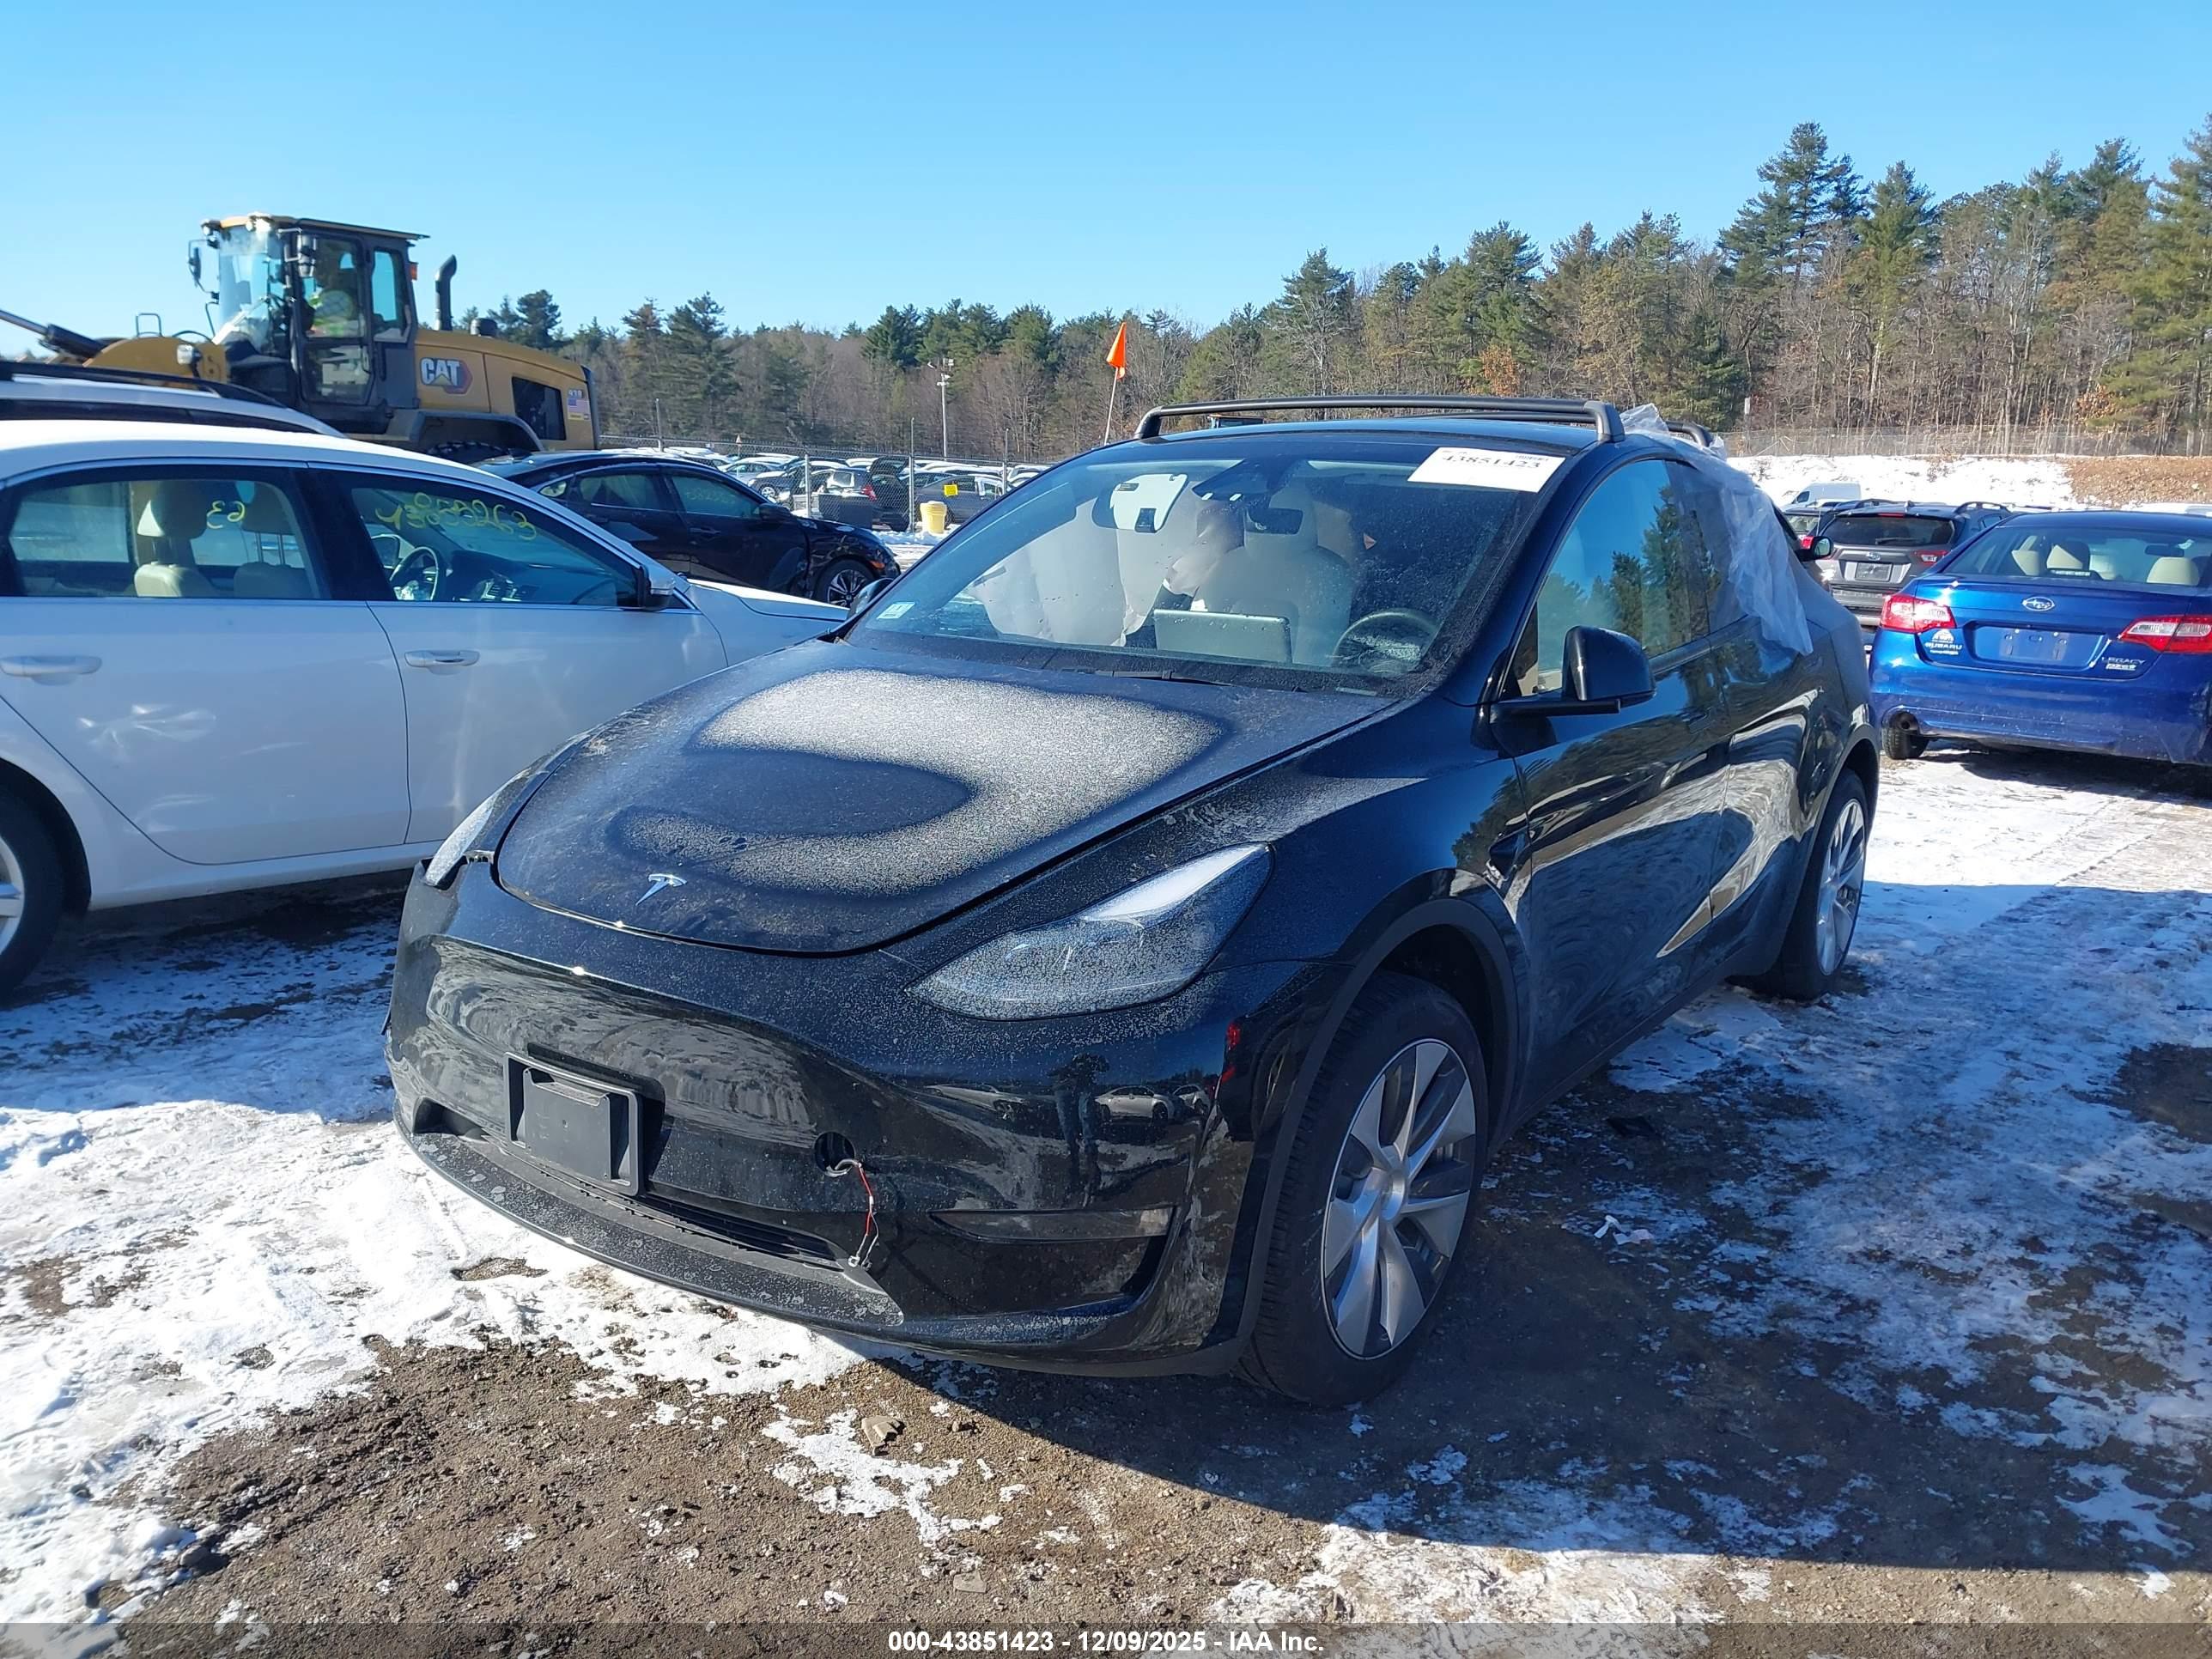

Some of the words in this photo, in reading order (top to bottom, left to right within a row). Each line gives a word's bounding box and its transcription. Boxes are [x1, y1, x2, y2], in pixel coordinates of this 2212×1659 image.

[421, 357, 460, 386] CAT
[1443, 455, 1540, 468] 43851423
[2101, 656, 2146, 665] LEGACY
